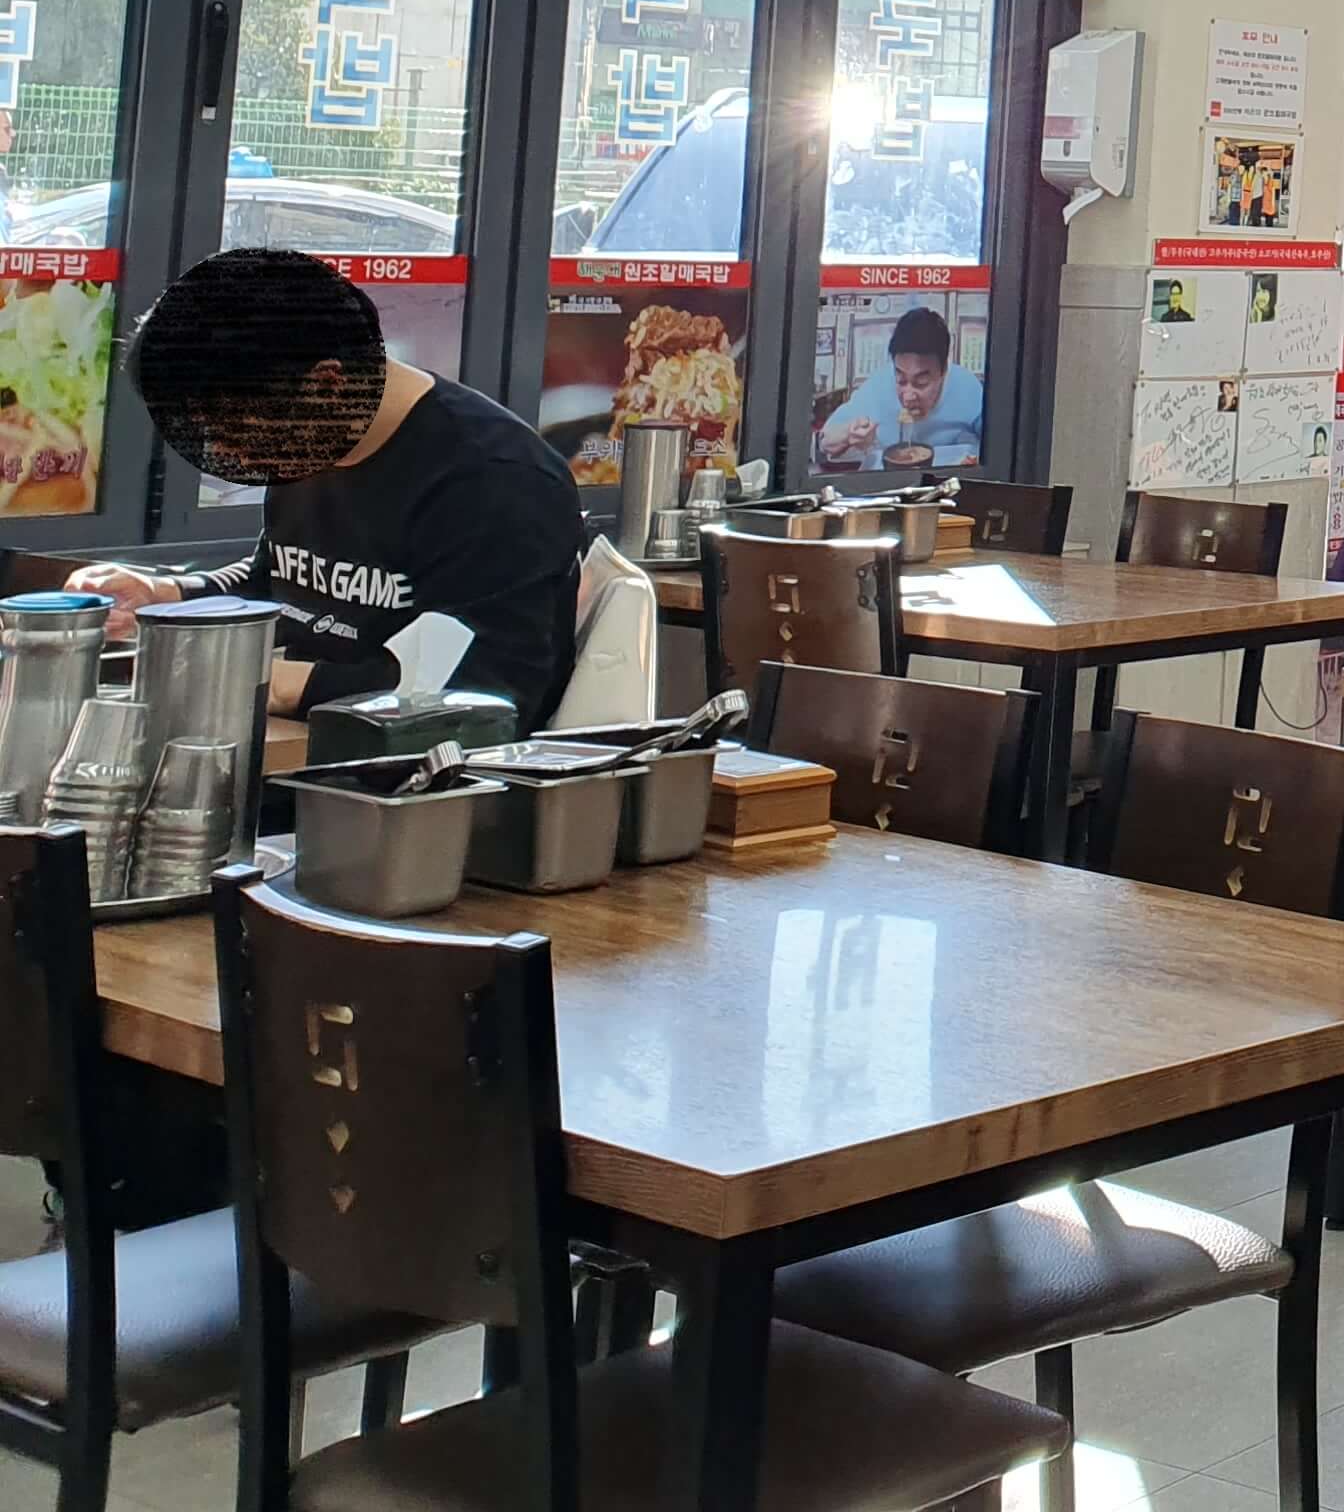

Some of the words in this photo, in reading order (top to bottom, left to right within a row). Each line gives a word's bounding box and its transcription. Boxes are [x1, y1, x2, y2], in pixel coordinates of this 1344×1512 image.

[362, 258, 412, 280] 1962
[624, 263, 731, 284] 원조할매국밥
[860, 267, 909, 285] SINCE
[916, 267, 951, 285] 1962
[268, 540, 309, 588] LIFE
[312, 554, 328, 595] IS
[330, 561, 415, 610] GAME
